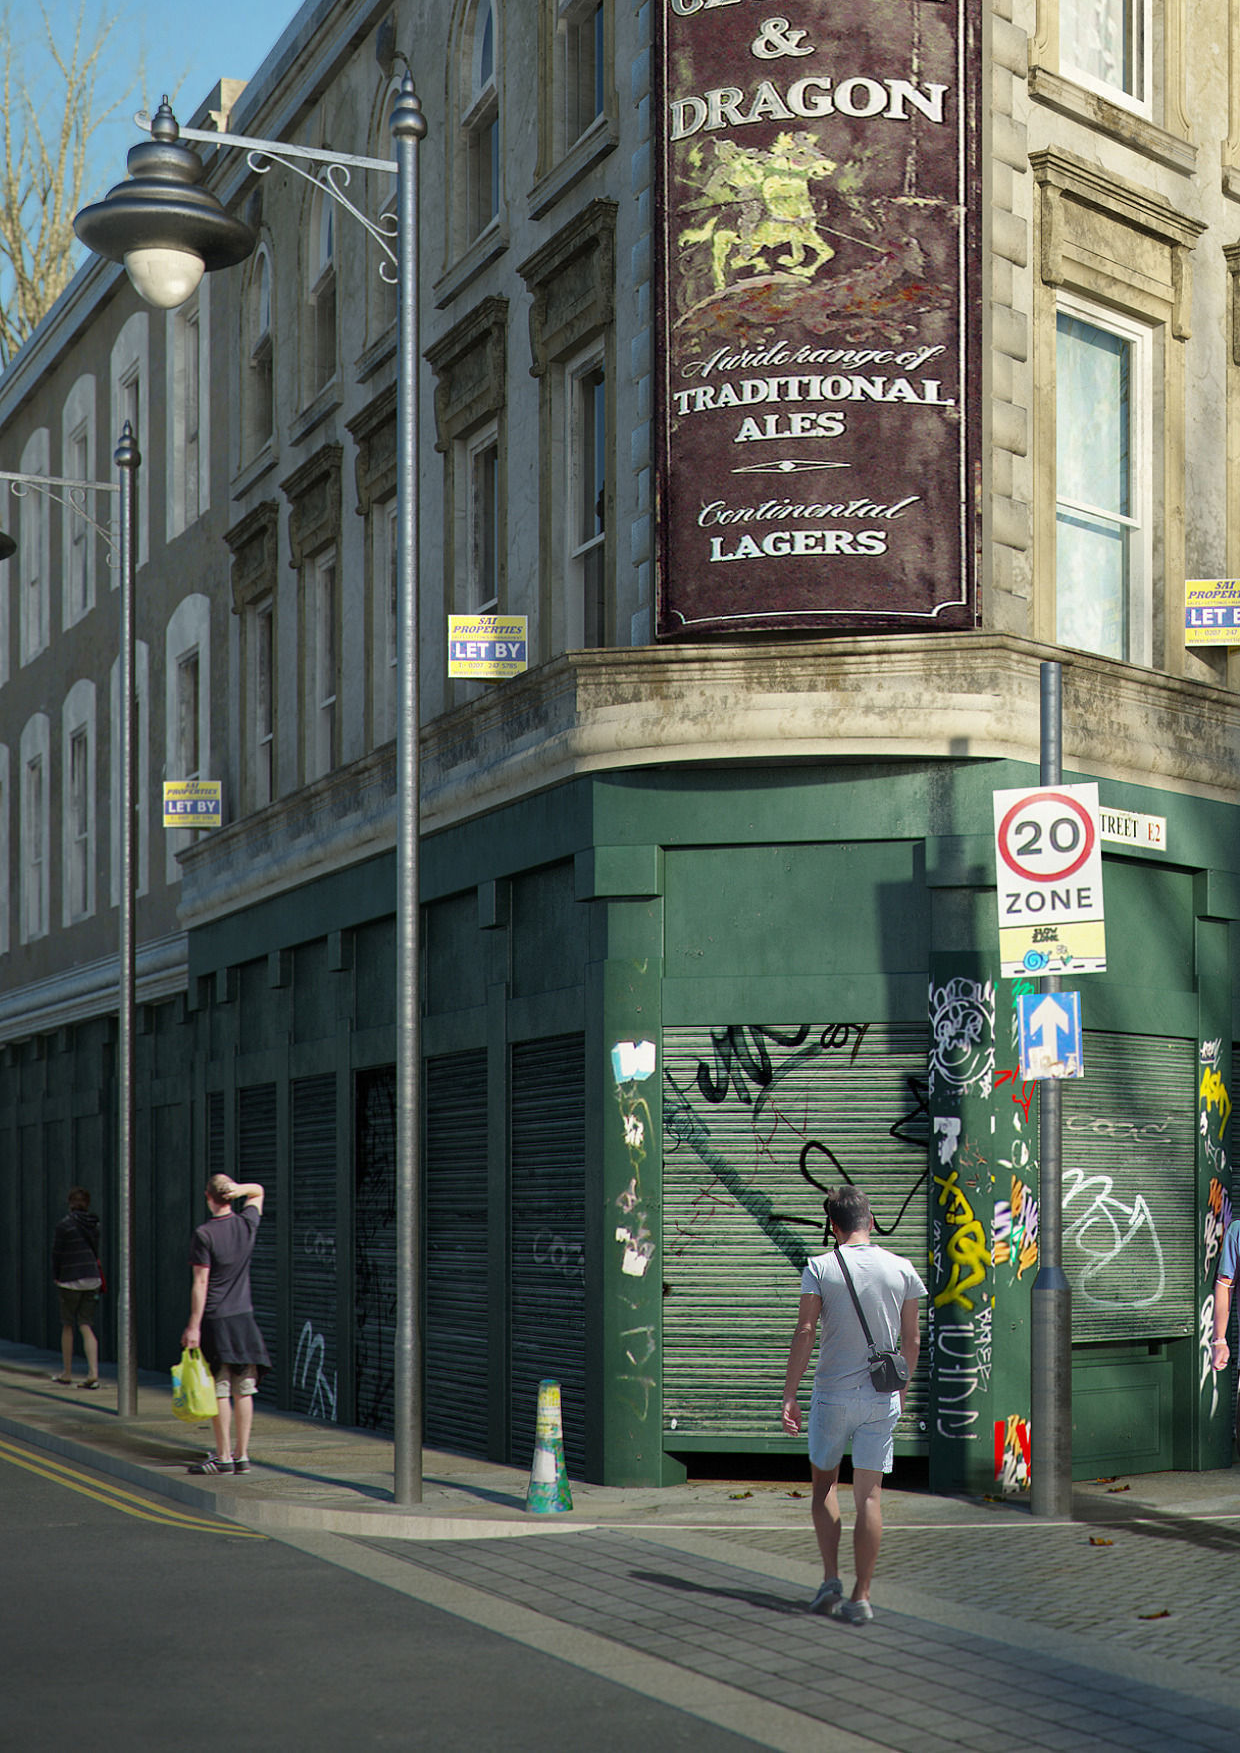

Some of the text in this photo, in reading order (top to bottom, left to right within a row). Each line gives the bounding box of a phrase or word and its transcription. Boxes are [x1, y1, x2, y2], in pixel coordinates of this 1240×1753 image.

[752, 17, 815, 59] &
[670, 77, 948, 141] DRAGON
[789, 345, 895, 371] range
[895, 345, 947, 371] of
[673, 375, 955, 415] TRADITIONAL
[734, 411, 845, 443] ALES
[697, 496, 920, 527] Continental
[709, 530, 888, 562] LAGERS
[1215, 581, 1236, 589] SAI
[453, 625, 523, 634] PROPERTIES
[478, 617, 498, 625] SAI
[1190, 608, 1227, 625] LET
[455, 642, 520, 658] LET BY
[168, 801, 216, 813] LET BY
[1014, 817, 1080, 856] 20
[1099, 814, 1160, 842] TREET E2
[1005, 887, 1093, 914] ZONE
